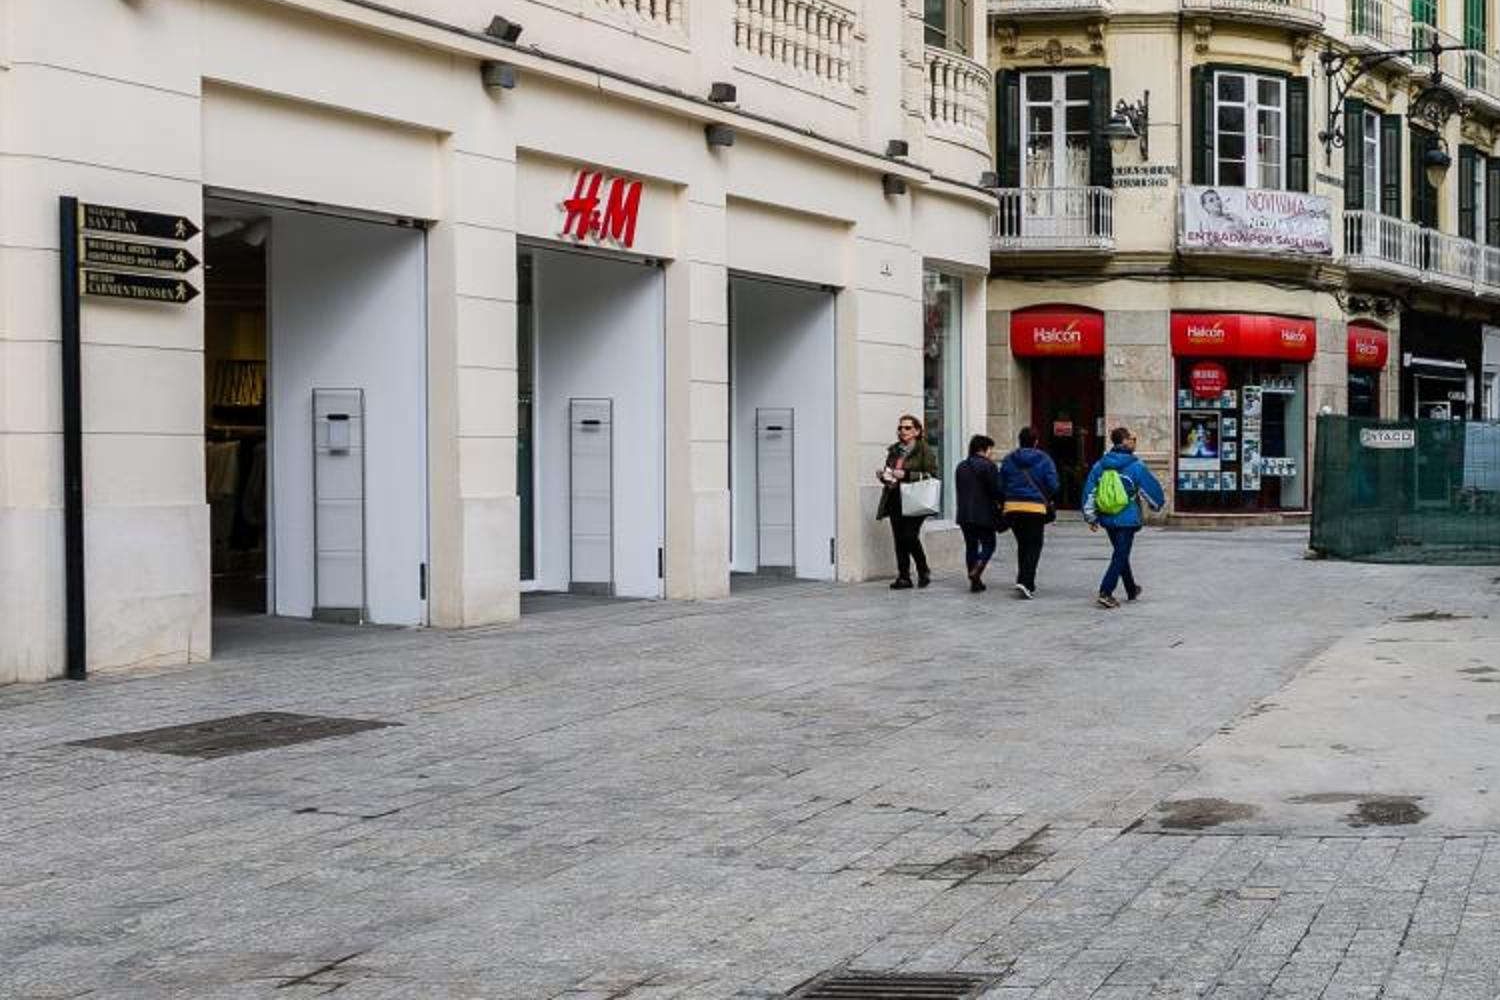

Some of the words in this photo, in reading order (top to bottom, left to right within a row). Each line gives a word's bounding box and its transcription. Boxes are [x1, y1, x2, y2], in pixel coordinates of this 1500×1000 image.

[563, 166, 643, 248] H&M
[1033, 322, 1081, 343] Halcón
[1187, 323, 1225, 338] Halcón
